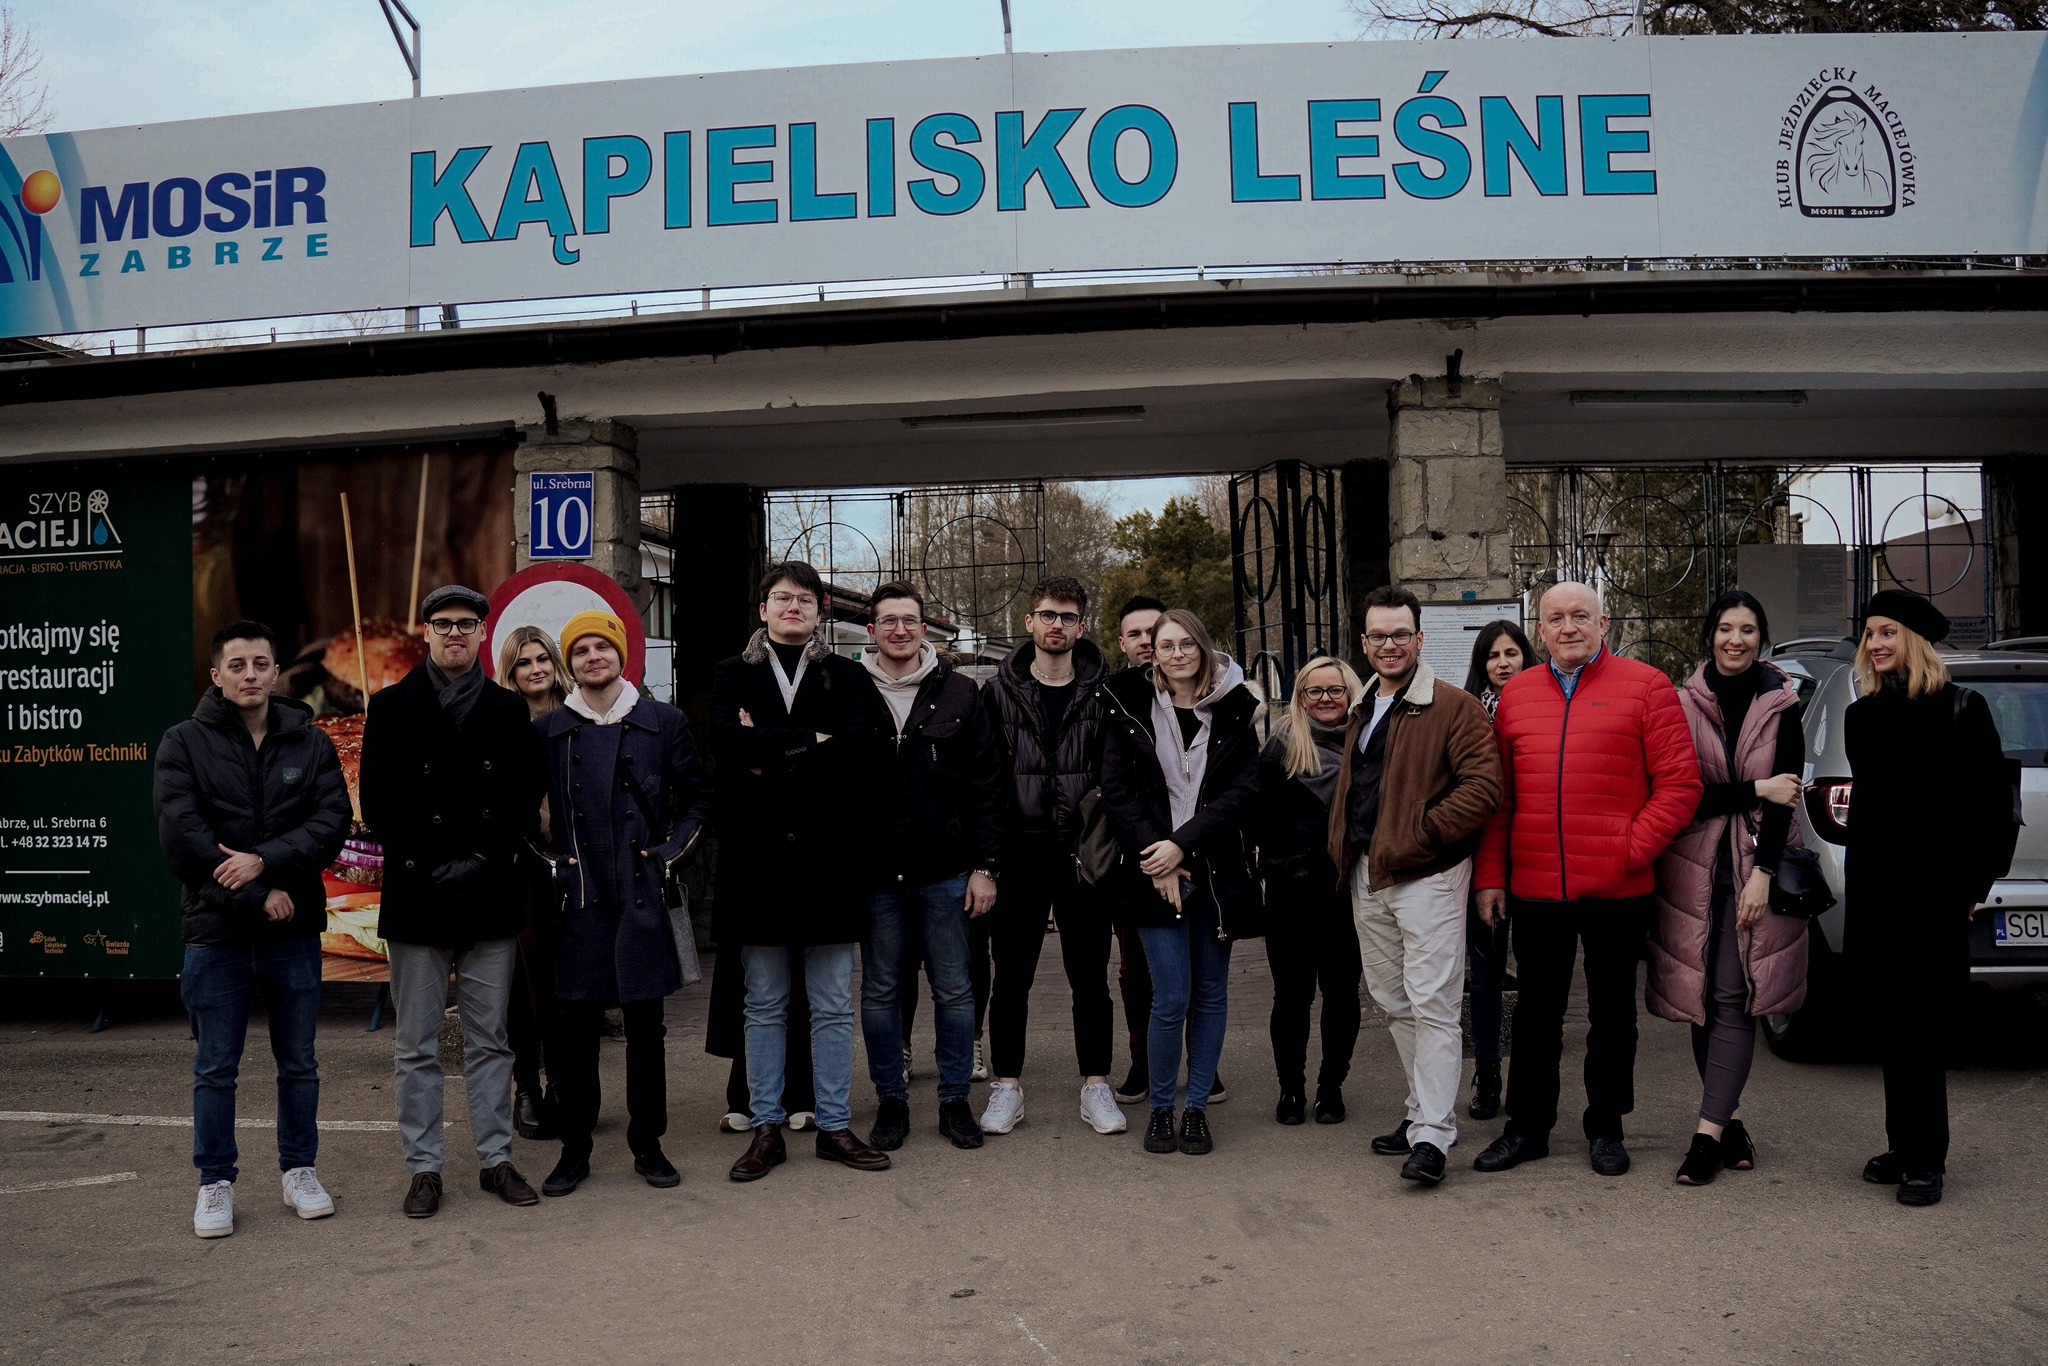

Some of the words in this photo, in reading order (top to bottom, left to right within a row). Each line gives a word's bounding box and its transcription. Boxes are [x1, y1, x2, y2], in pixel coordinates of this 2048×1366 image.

[1778, 67, 1858, 151] JEŹDZIECKI
[1863, 85, 1917, 209] MACIEJÓWKA
[410, 104, 1179, 265] KĄPIELISKO
[1228, 70, 1657, 203] LEŚNE
[1776, 159, 1793, 209] KLUB
[79, 166, 329, 246] MOSiR
[1810, 208, 1845, 216] MOSIR
[1850, 208, 1885, 216] Zabrze
[79, 233, 329, 278] ZABRZE
[533, 478, 547, 490] ul.
[548, 478, 592, 490] Srebrna
[28, 491, 82, 515] SZYB
[534, 496, 589, 550] 10
[31, 562, 64, 573] BISTRO
[69, 559, 123, 572] TURYSTYKA
[89, 619, 120, 653] się
[0, 660, 115, 695] restauracji
[8, 703, 13, 731] i
[19, 703, 83, 731] bistro
[14, 744, 84, 768] Zabytków
[87, 742, 148, 762] Techniki
[33, 817, 48, 829] ul.
[51, 817, 97, 829] Srebrna
[99, 817, 107, 828] 6
[11, 836, 34, 849] +48
[35, 836, 50, 848] 32
[52, 836, 74, 848] 323
[76, 836, 91, 848] 14
[92, 836, 108, 848] 75
[0, 890, 110, 908] ww.szybmaciej.pl
